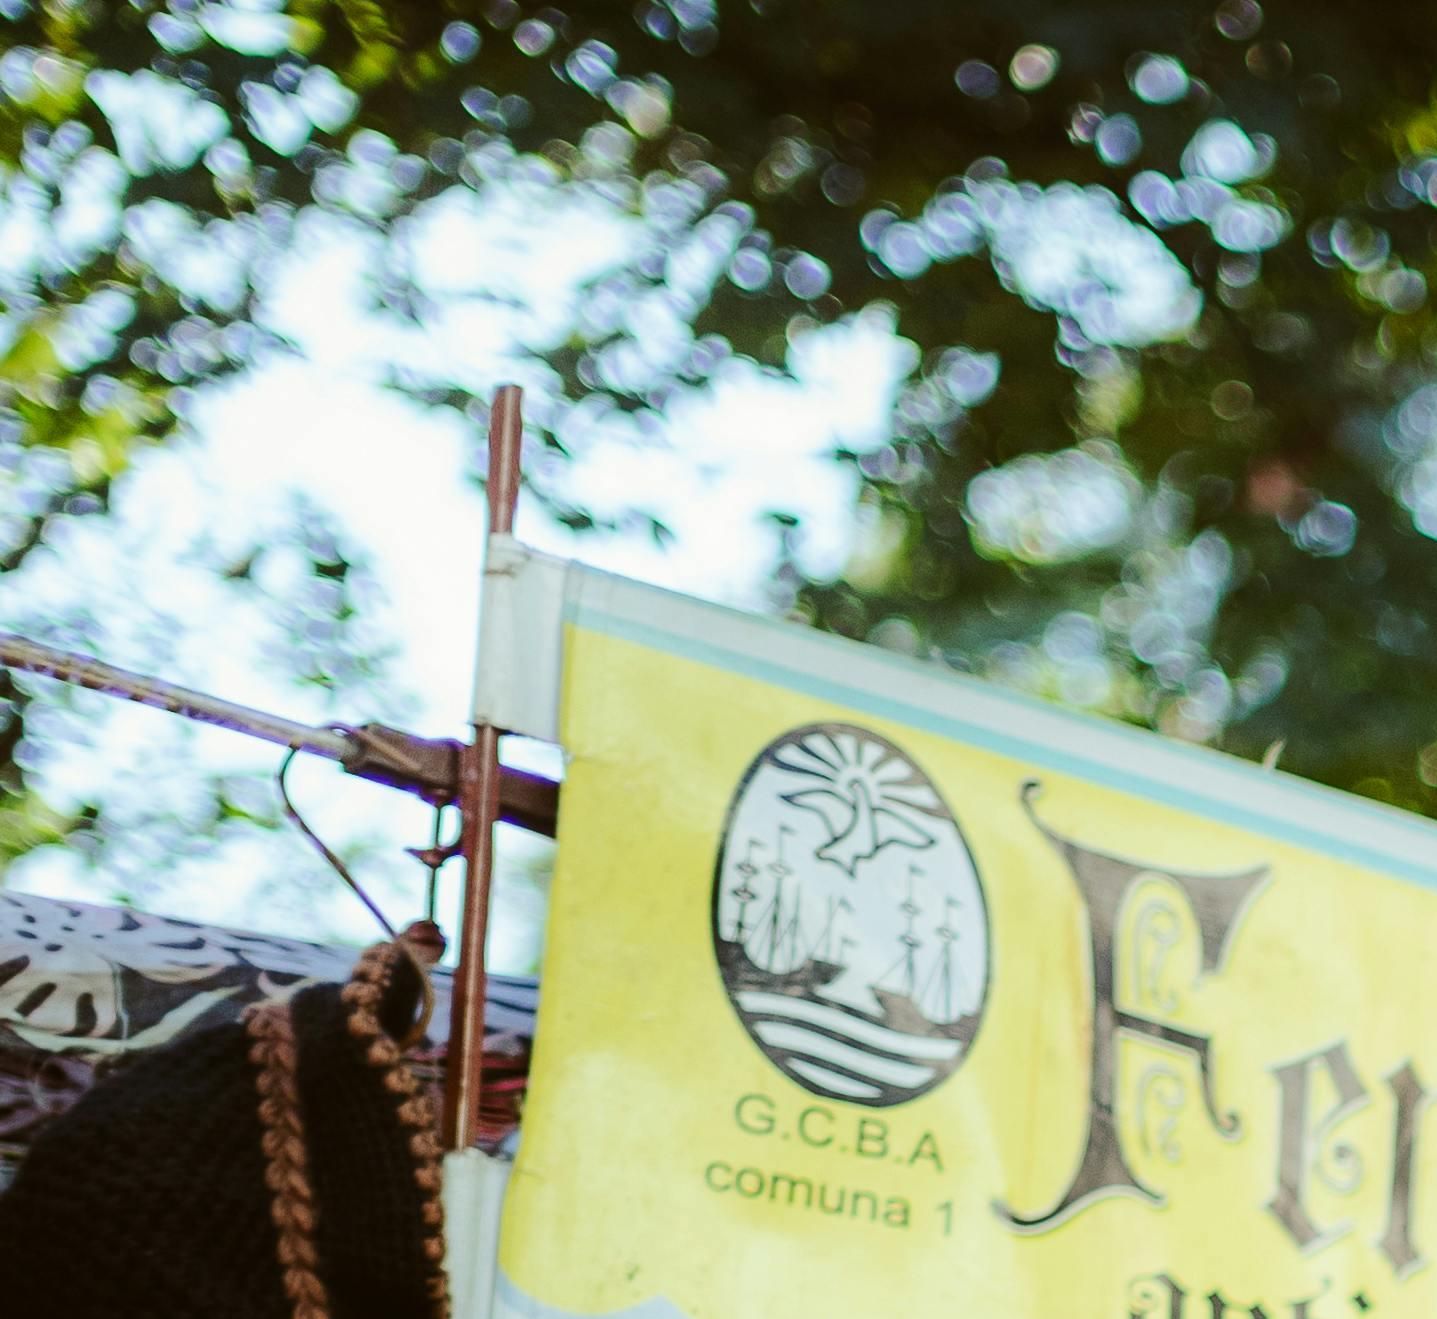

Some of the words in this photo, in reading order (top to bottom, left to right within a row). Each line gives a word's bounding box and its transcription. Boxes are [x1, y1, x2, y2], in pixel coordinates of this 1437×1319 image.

[733, 1092, 945, 1173] G.C.B.A
[704, 1160, 911, 1229] comuna
[936, 1199, 953, 1237] 1
